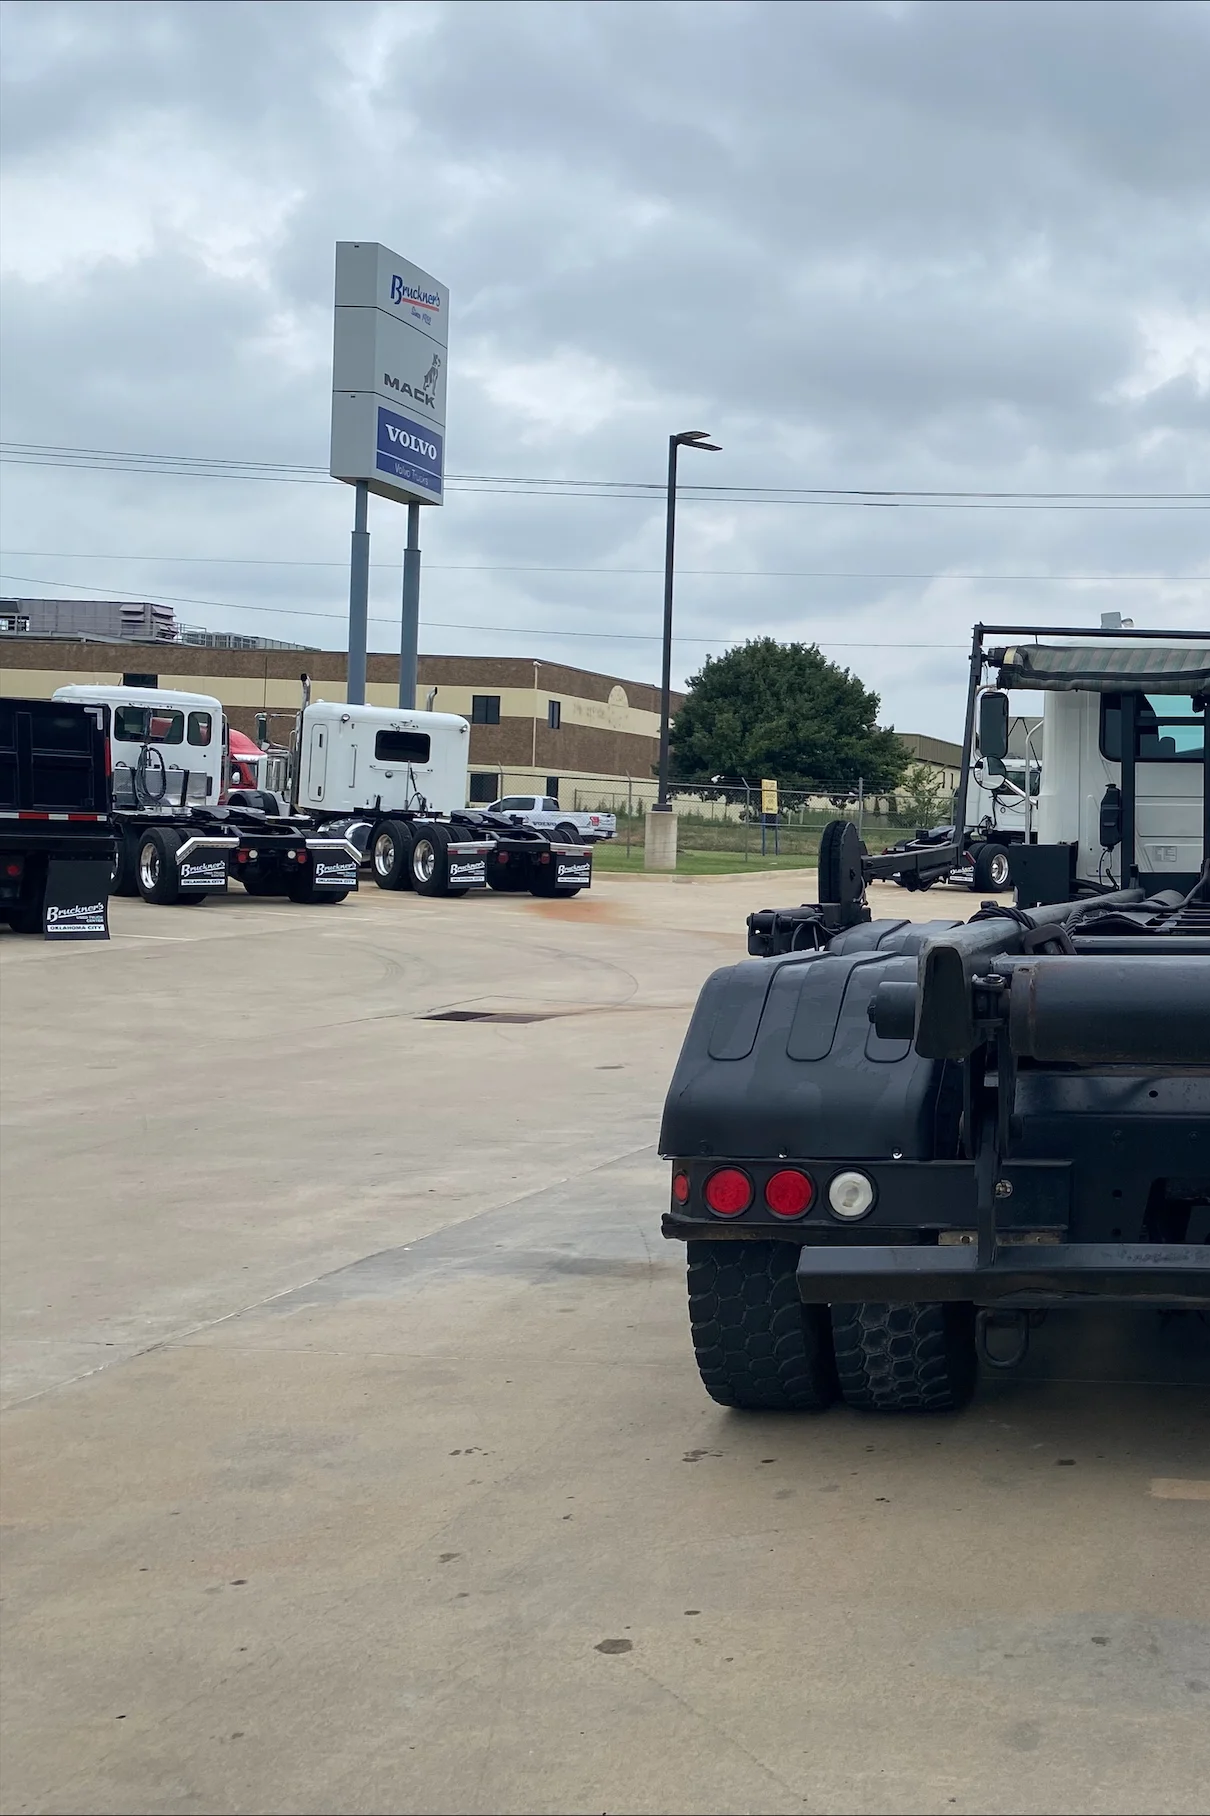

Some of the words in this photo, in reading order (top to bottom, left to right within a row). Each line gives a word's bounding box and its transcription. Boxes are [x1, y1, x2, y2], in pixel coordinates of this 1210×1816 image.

[390, 274, 441, 307] Bruckner's
[384, 373, 436, 410] MACK
[385, 423, 437, 460] VOLVO
[181, 860, 226, 877] Bruckner's
[315, 861, 357, 876] Bruckner's
[46, 902, 104, 922] Bruckner's
